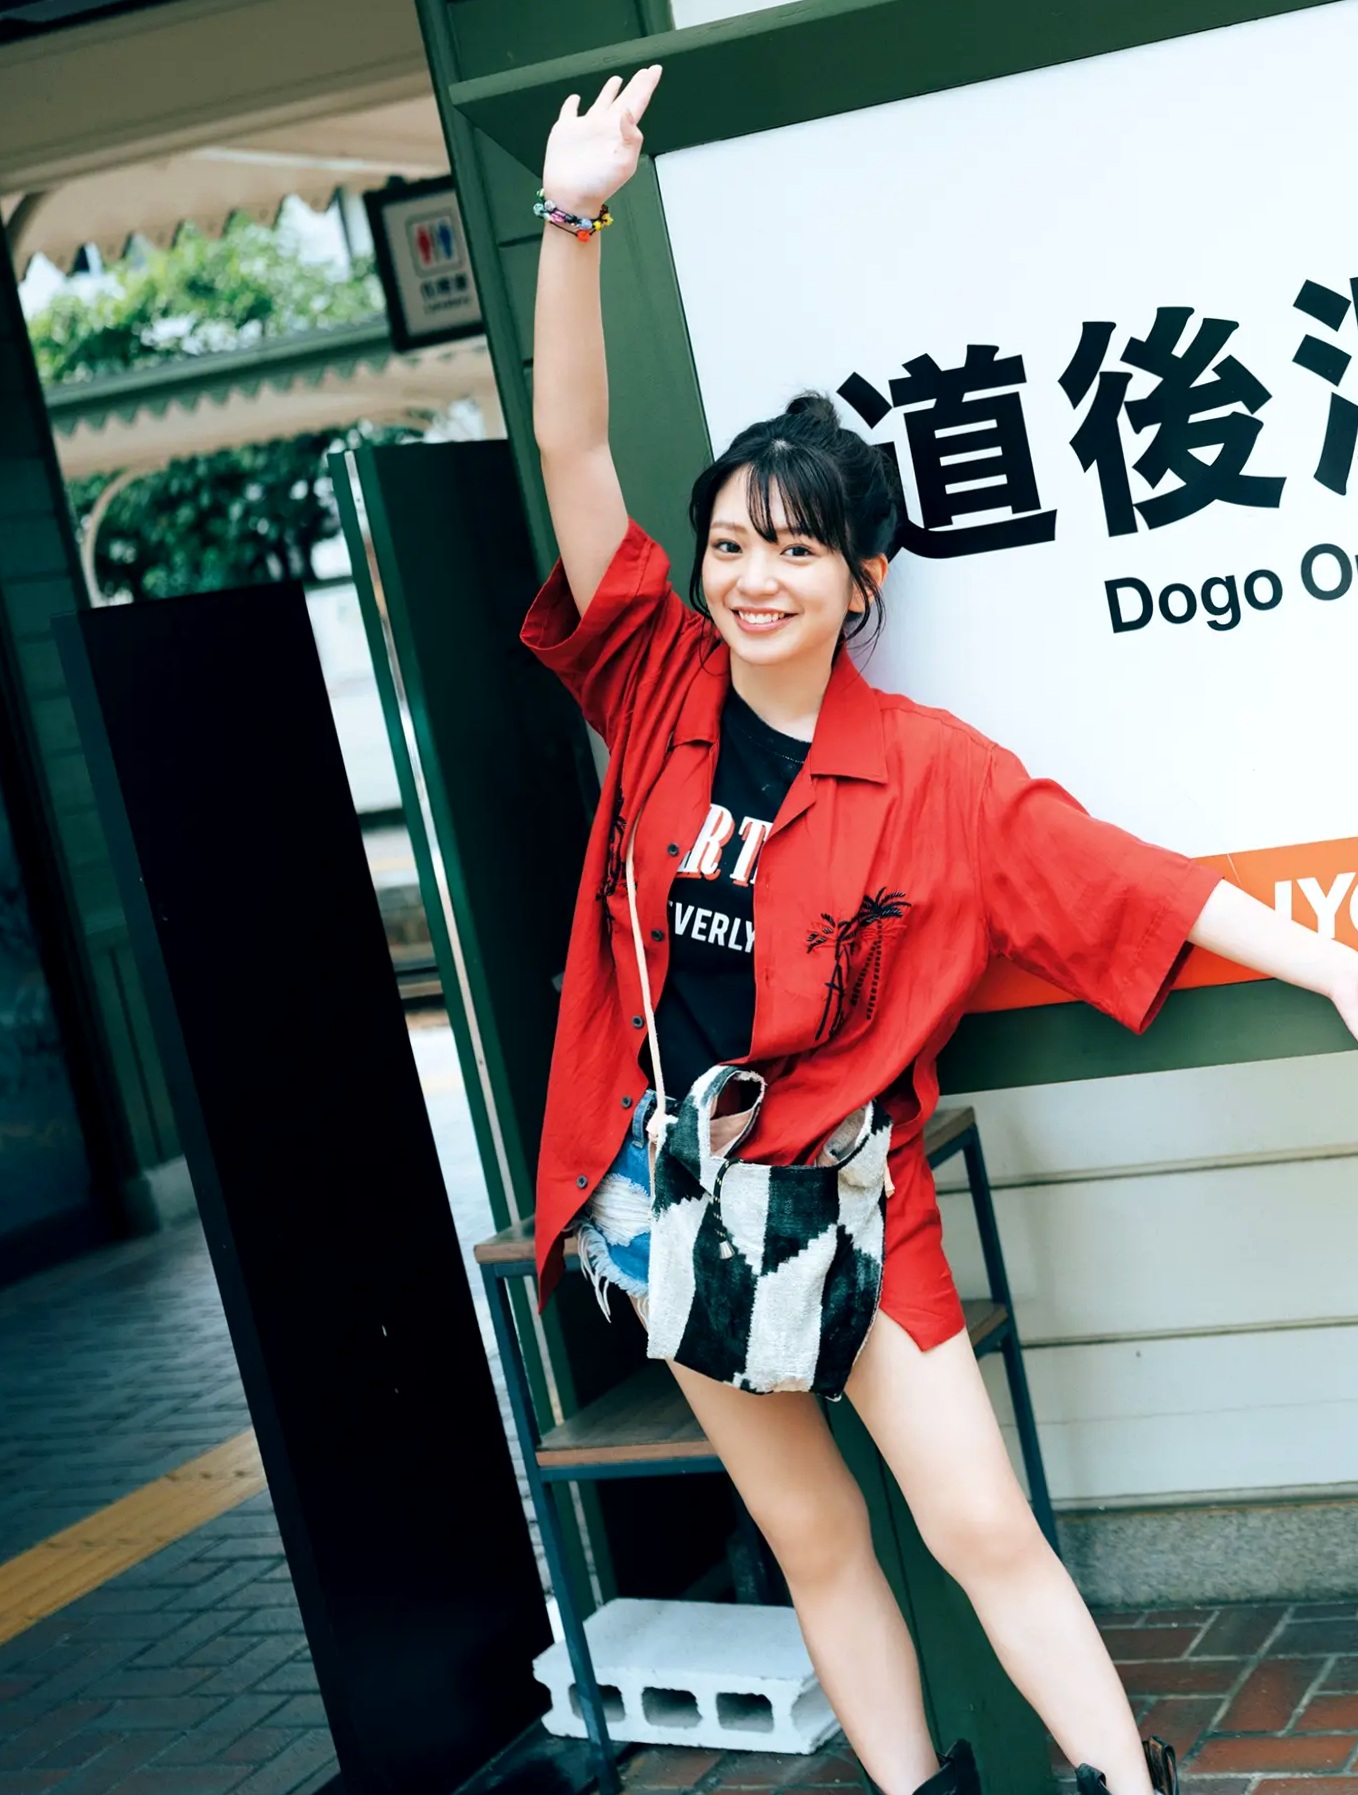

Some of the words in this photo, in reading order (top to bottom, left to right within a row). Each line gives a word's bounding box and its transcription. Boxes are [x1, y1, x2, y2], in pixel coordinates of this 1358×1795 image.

[1105, 569, 1283, 633] Dogo
[676, 803, 773, 888] RT
[668, 900, 756, 953] VERLY
